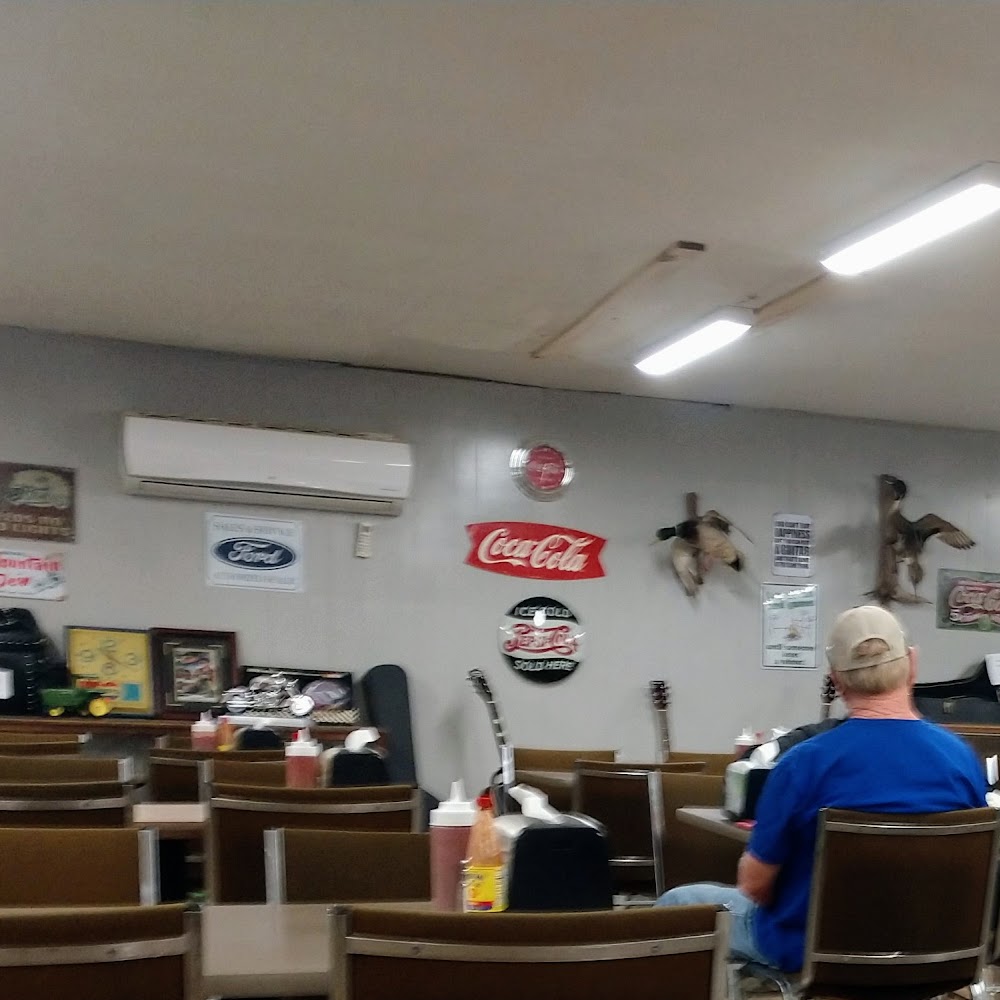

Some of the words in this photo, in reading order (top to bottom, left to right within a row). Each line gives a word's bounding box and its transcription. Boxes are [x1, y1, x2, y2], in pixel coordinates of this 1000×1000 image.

[228, 541, 284, 564] Ford
[477, 528, 597, 572] Coca-Cola
[0, 556, 63, 572] ountain
[546, 660, 575, 672] HERE
